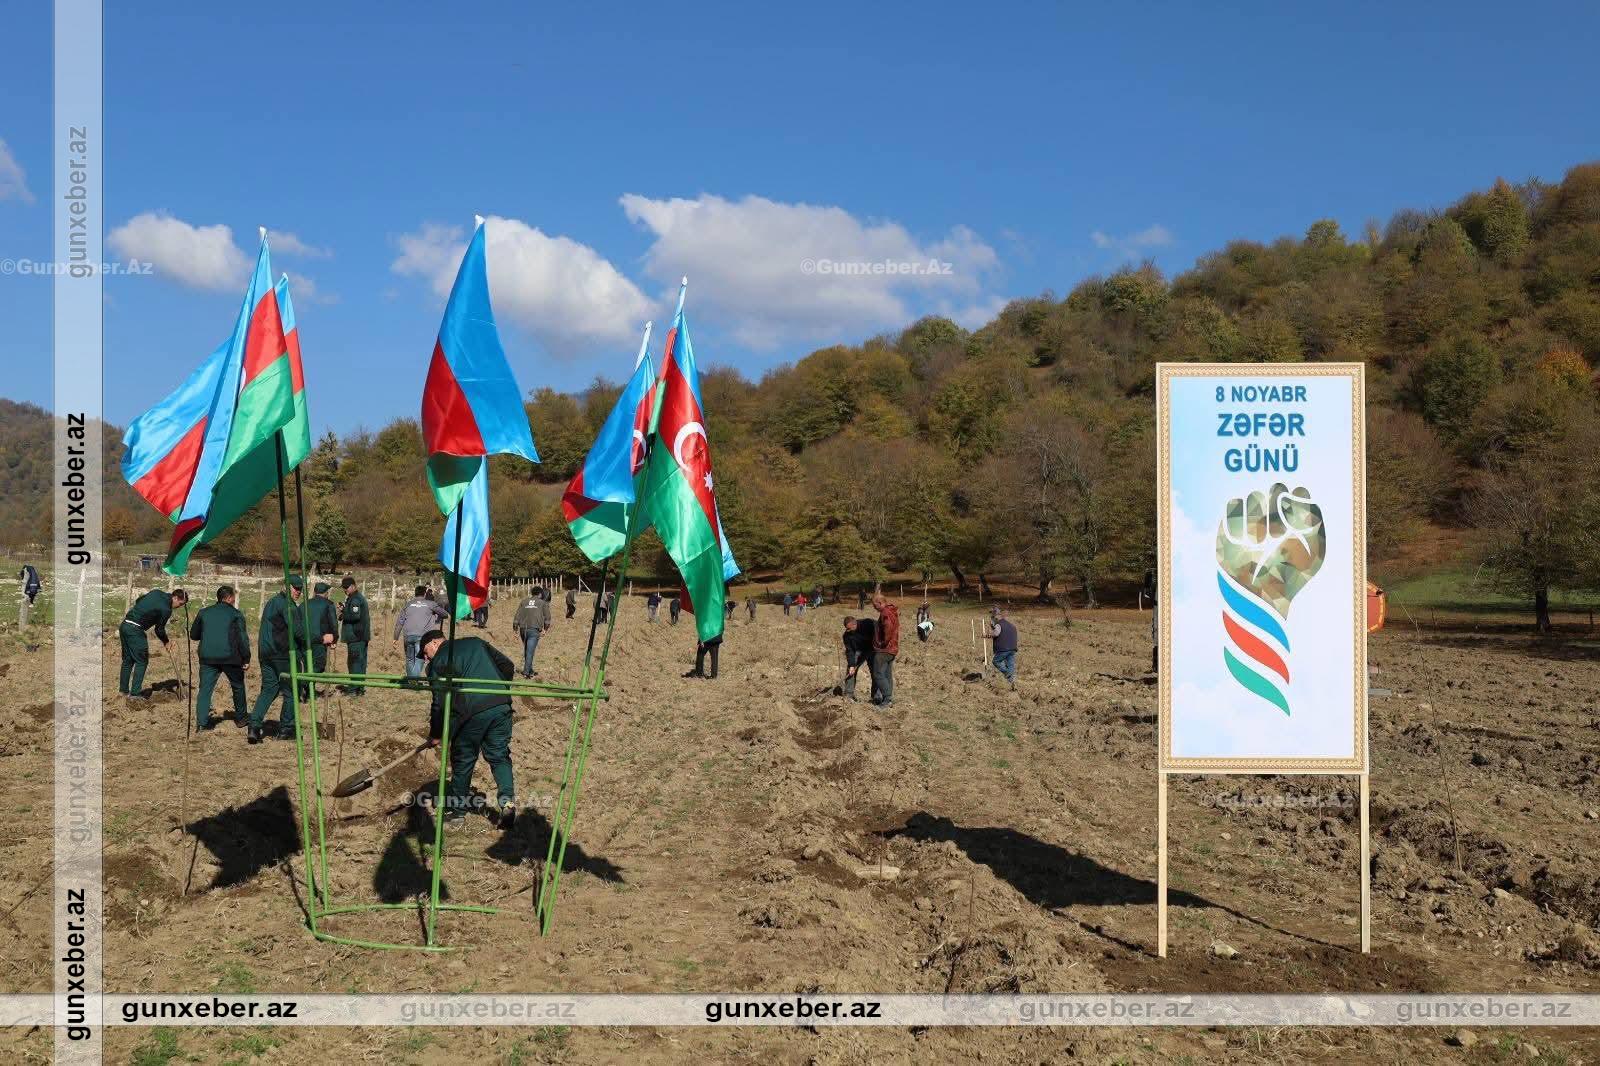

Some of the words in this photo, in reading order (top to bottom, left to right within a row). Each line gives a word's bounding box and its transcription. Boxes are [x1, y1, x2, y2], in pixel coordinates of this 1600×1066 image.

[1215, 386, 1225, 402] 8
[1231, 385, 1307, 402] NOYABR
[1217, 412, 1305, 437] ZƏFƏR
[1224, 443, 1299, 473] GÜNÜ
